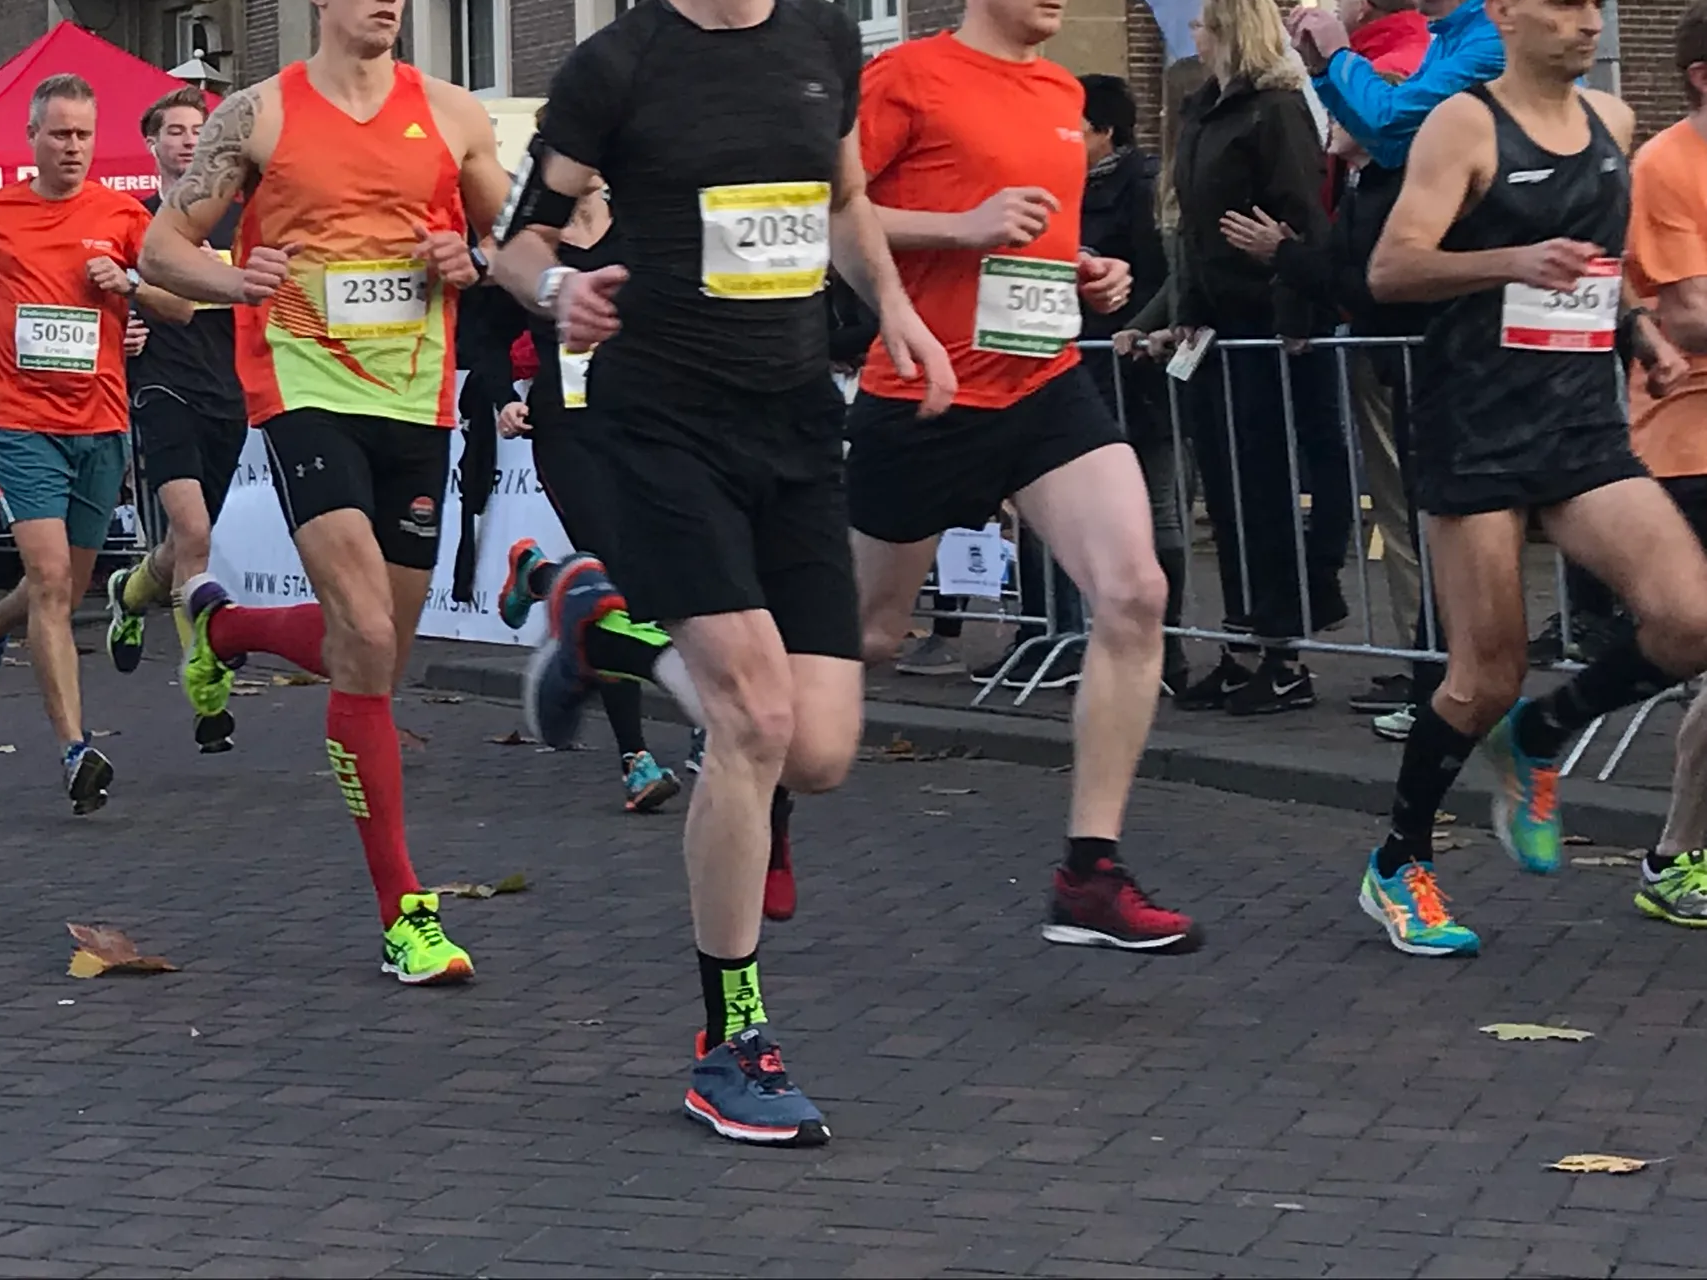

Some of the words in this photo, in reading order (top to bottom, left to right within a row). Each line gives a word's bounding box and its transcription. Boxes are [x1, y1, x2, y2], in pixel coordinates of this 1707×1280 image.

[100, 175, 163, 192] VEREN
[343, 276, 413, 304] 2335
[31, 323, 84, 343] 5050
